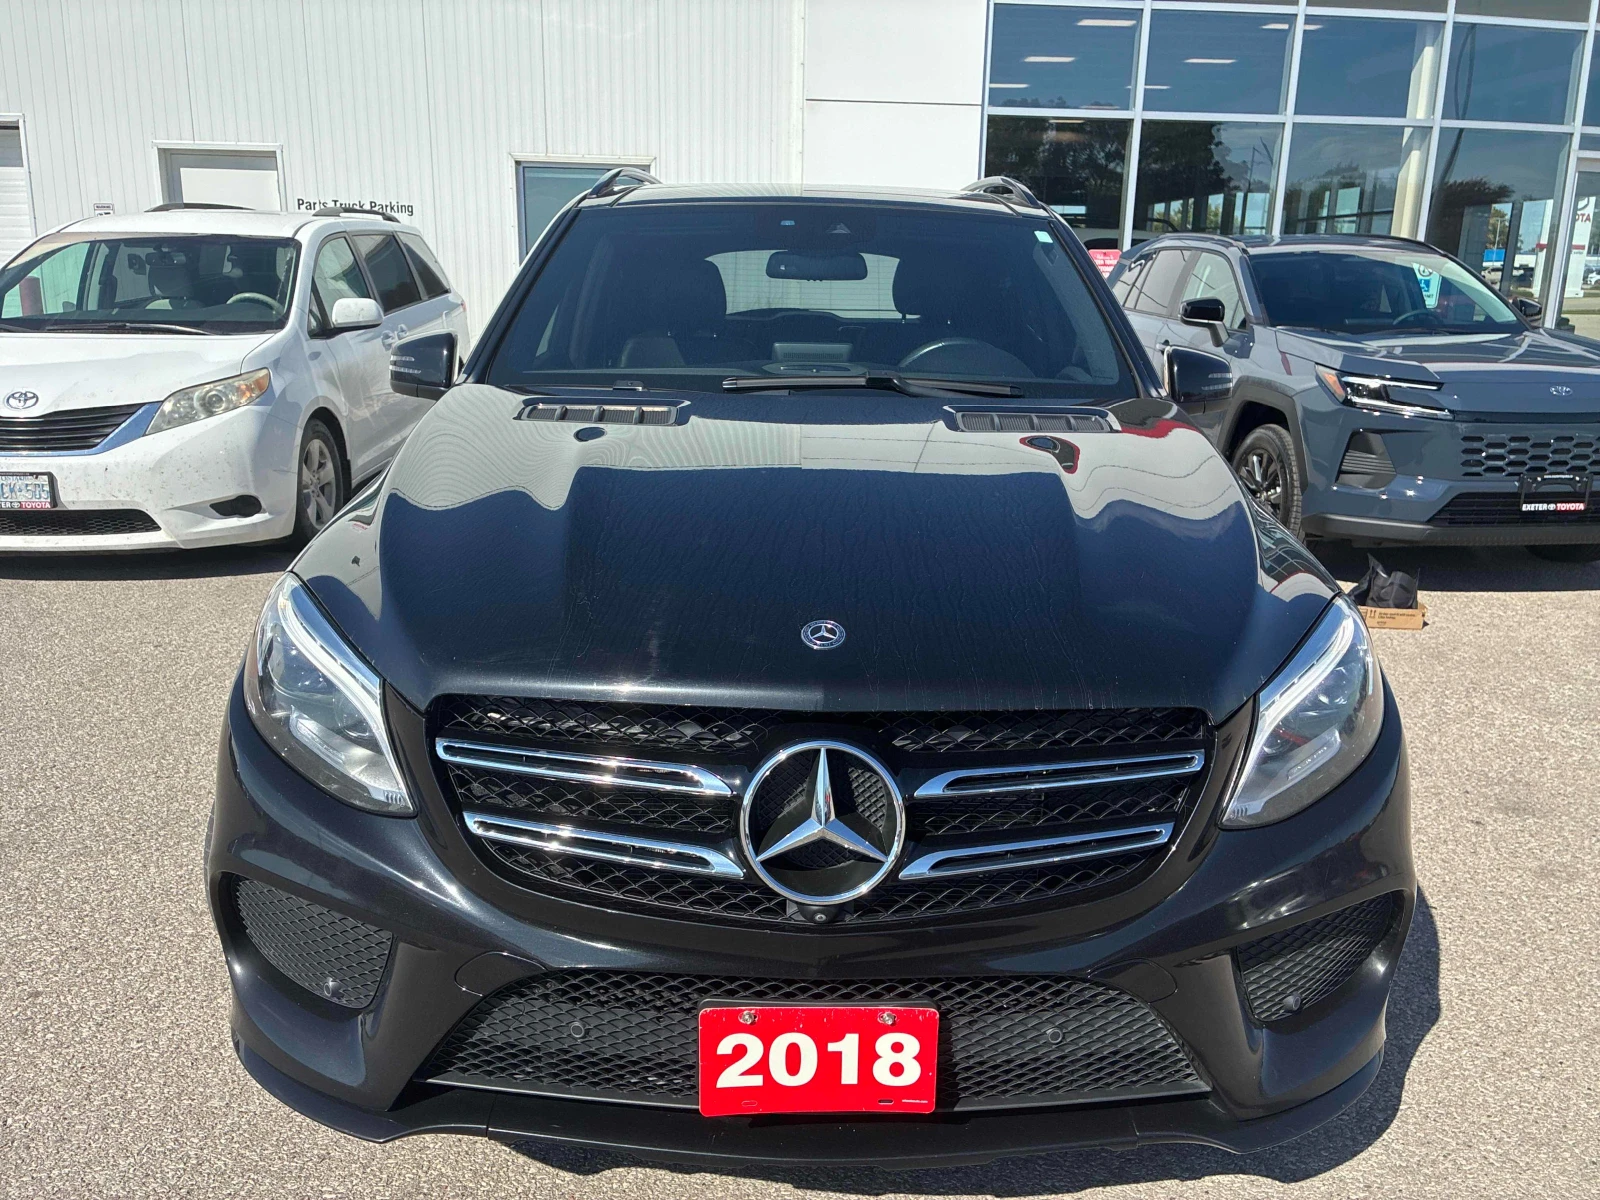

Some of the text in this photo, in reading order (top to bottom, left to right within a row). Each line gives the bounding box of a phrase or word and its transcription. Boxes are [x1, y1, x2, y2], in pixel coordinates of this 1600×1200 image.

[297, 198, 328, 210] Parts
[370, 201, 414, 216] Parking
[1522, 503, 1548, 511] EXETER
[716, 1032, 921, 1088] 2018
